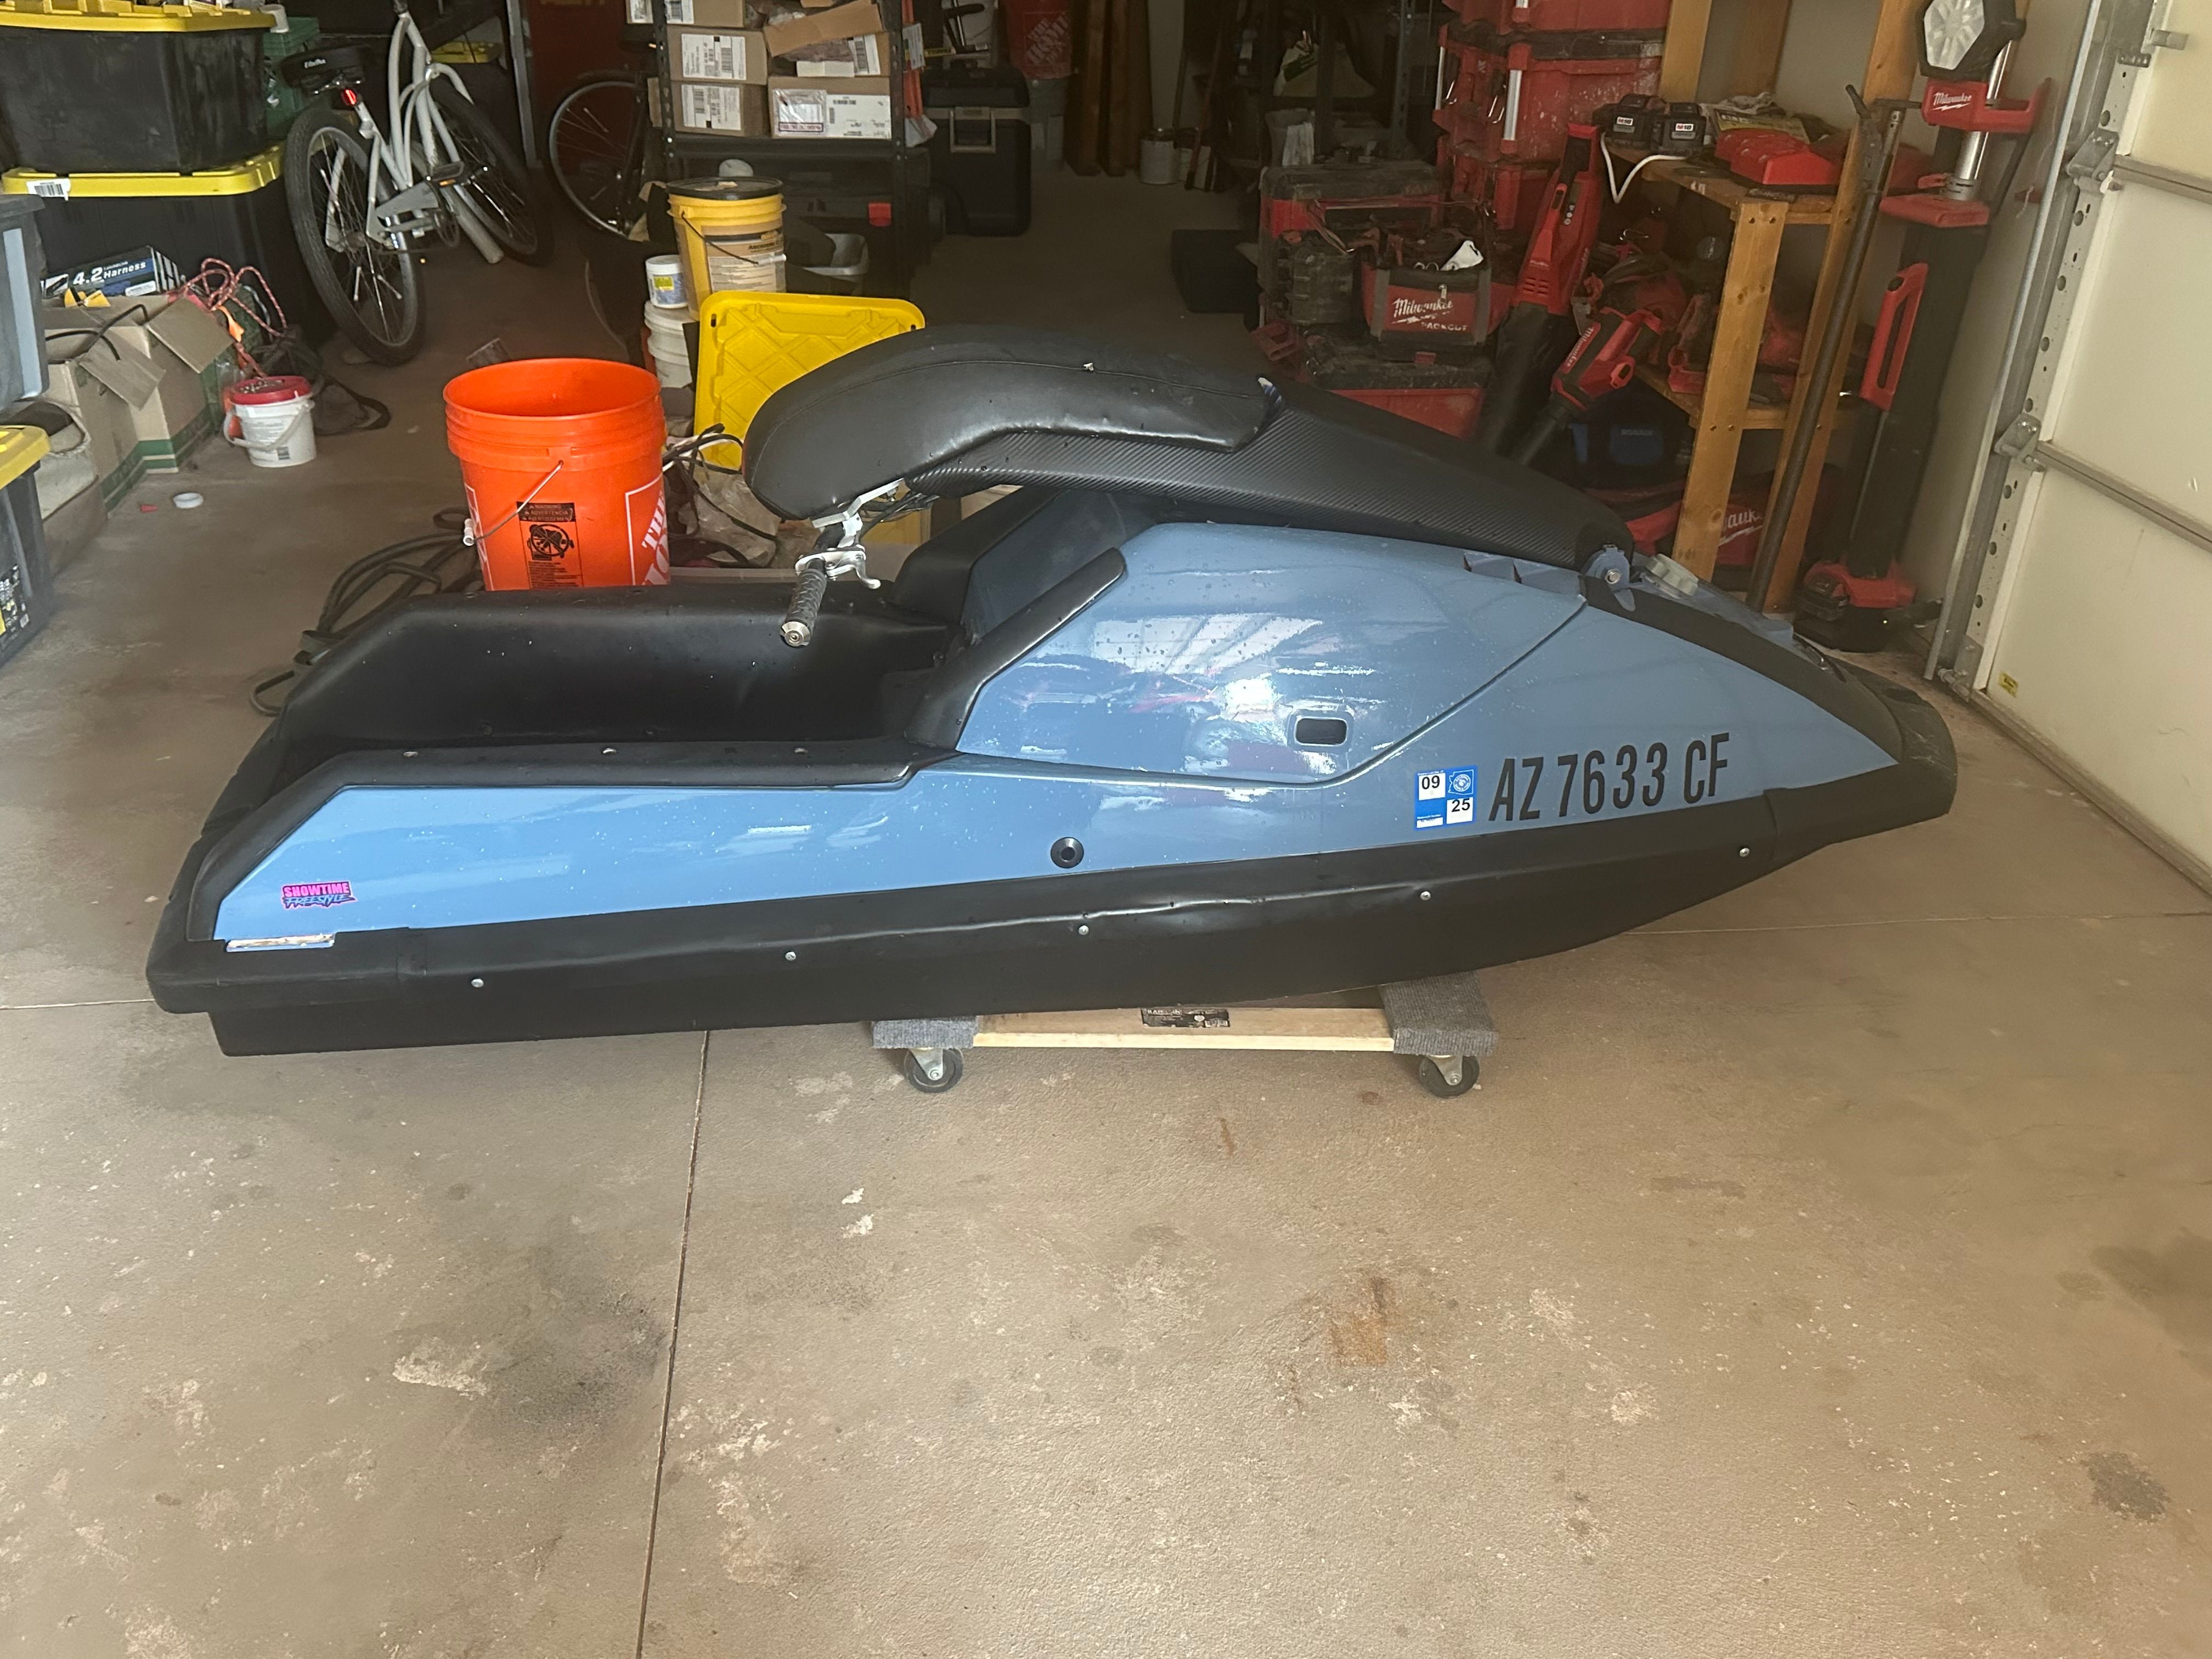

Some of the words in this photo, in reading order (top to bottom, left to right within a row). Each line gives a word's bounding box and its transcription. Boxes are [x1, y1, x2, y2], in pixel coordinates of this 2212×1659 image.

[1933, 92, 1972, 106] Milwaukee
[72, 267, 104, 286] 4.2
[103, 262, 146, 279] Harness
[1421, 775, 1440, 790] 09
[1488, 757, 1544, 822] AZ
[1557, 742, 1668, 817] 7633
[1683, 732, 1730, 804] CF
[1451, 797, 1470, 812] 25
[284, 883, 349, 898] SHOWTIME
[283, 893, 354, 908] FREESTYLE
